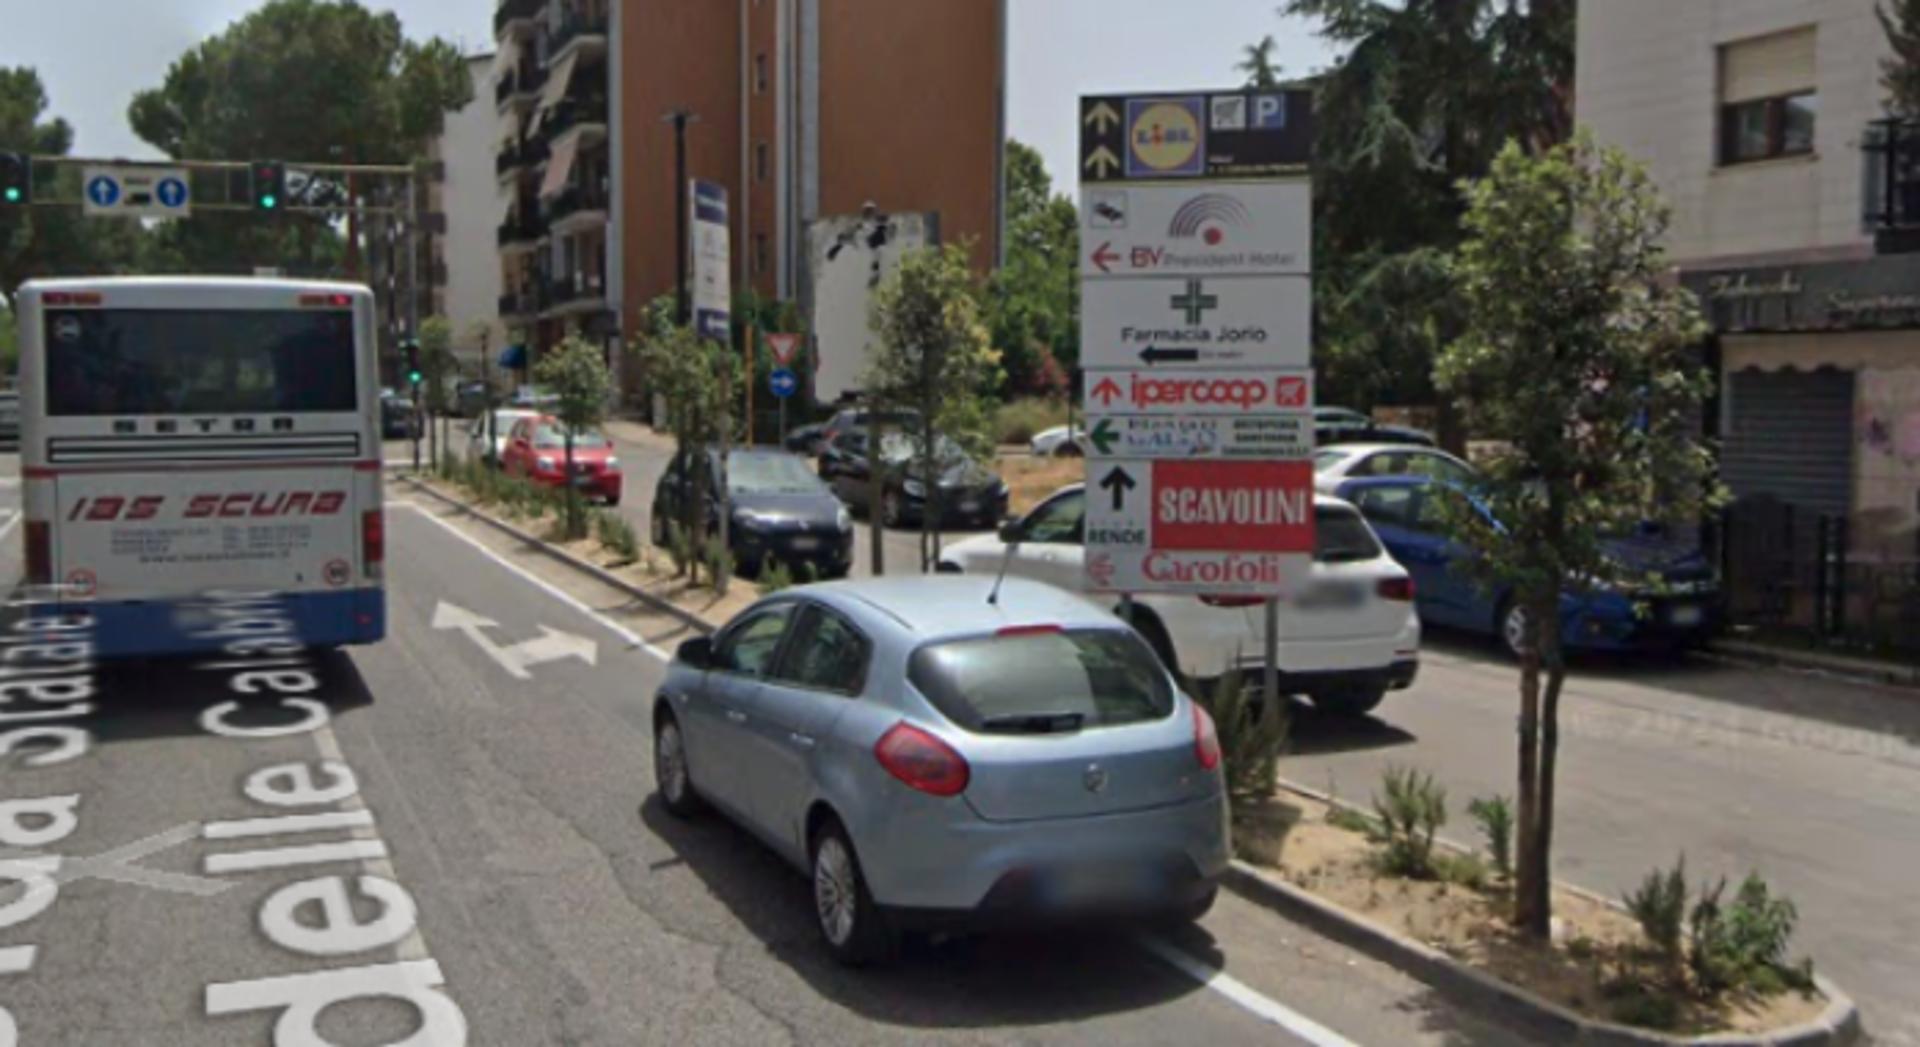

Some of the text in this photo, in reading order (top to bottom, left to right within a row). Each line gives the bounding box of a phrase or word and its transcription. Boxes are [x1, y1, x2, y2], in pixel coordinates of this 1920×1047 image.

[1121, 326, 1268, 343] Farmacia Jorio
[1131, 373, 1266, 409] ipercoop
[1158, 486, 1307, 525] SCAVOLINI
[1088, 529, 1145, 545] RENDE
